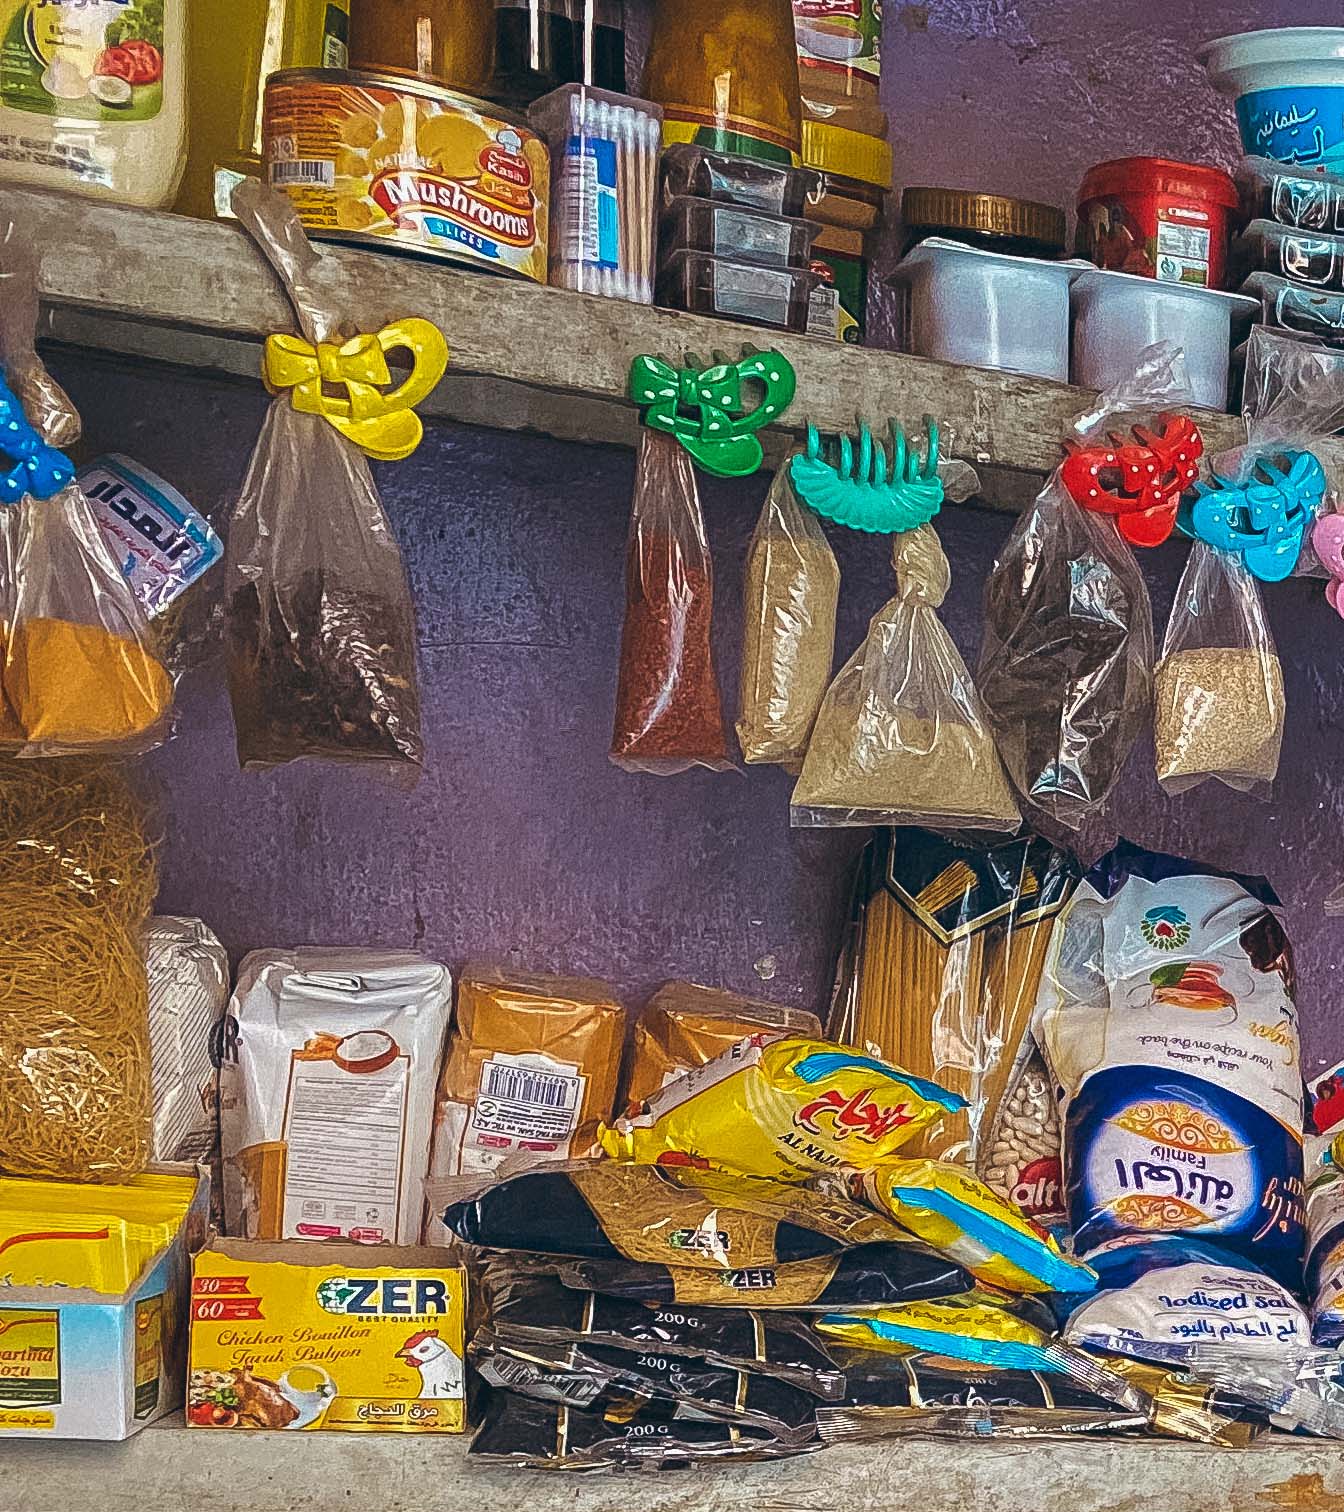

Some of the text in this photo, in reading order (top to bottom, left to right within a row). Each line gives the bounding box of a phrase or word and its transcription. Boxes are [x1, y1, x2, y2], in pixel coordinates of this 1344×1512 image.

[383, 176, 530, 238] Mushrooms
[436, 220, 484, 249] SLICES
[1136, 1034, 1168, 1047] back
[1194, 1039, 1211, 1050] on
[1212, 1041, 1248, 1060] recipe
[1247, 1051, 1275, 1071] Your
[778, 1131, 799, 1146] AL
[1150, 1145, 1207, 1170] Family
[1114, 1158, 1234, 1212] العائلة
[198, 1278, 220, 1293] 30
[731, 1269, 778, 1288] ZER
[346, 1278, 448, 1314] ZER
[197, 1300, 224, 1319] 60
[391, 1315, 439, 1323] QUALITY
[653, 1310, 701, 1329] 200 G
[1170, 1319, 1216, 1338] باليود
[216, 1324, 371, 1347] Chicken Bouillon
[1220, 1321, 1272, 1341] الطعام
[231, 1345, 362, 1365] Tavuk Bulyon
[635, 1355, 682, 1373] 200 G
[406, 1404, 439, 1420] مرق
[623, 1423, 670, 1438] 200 G
